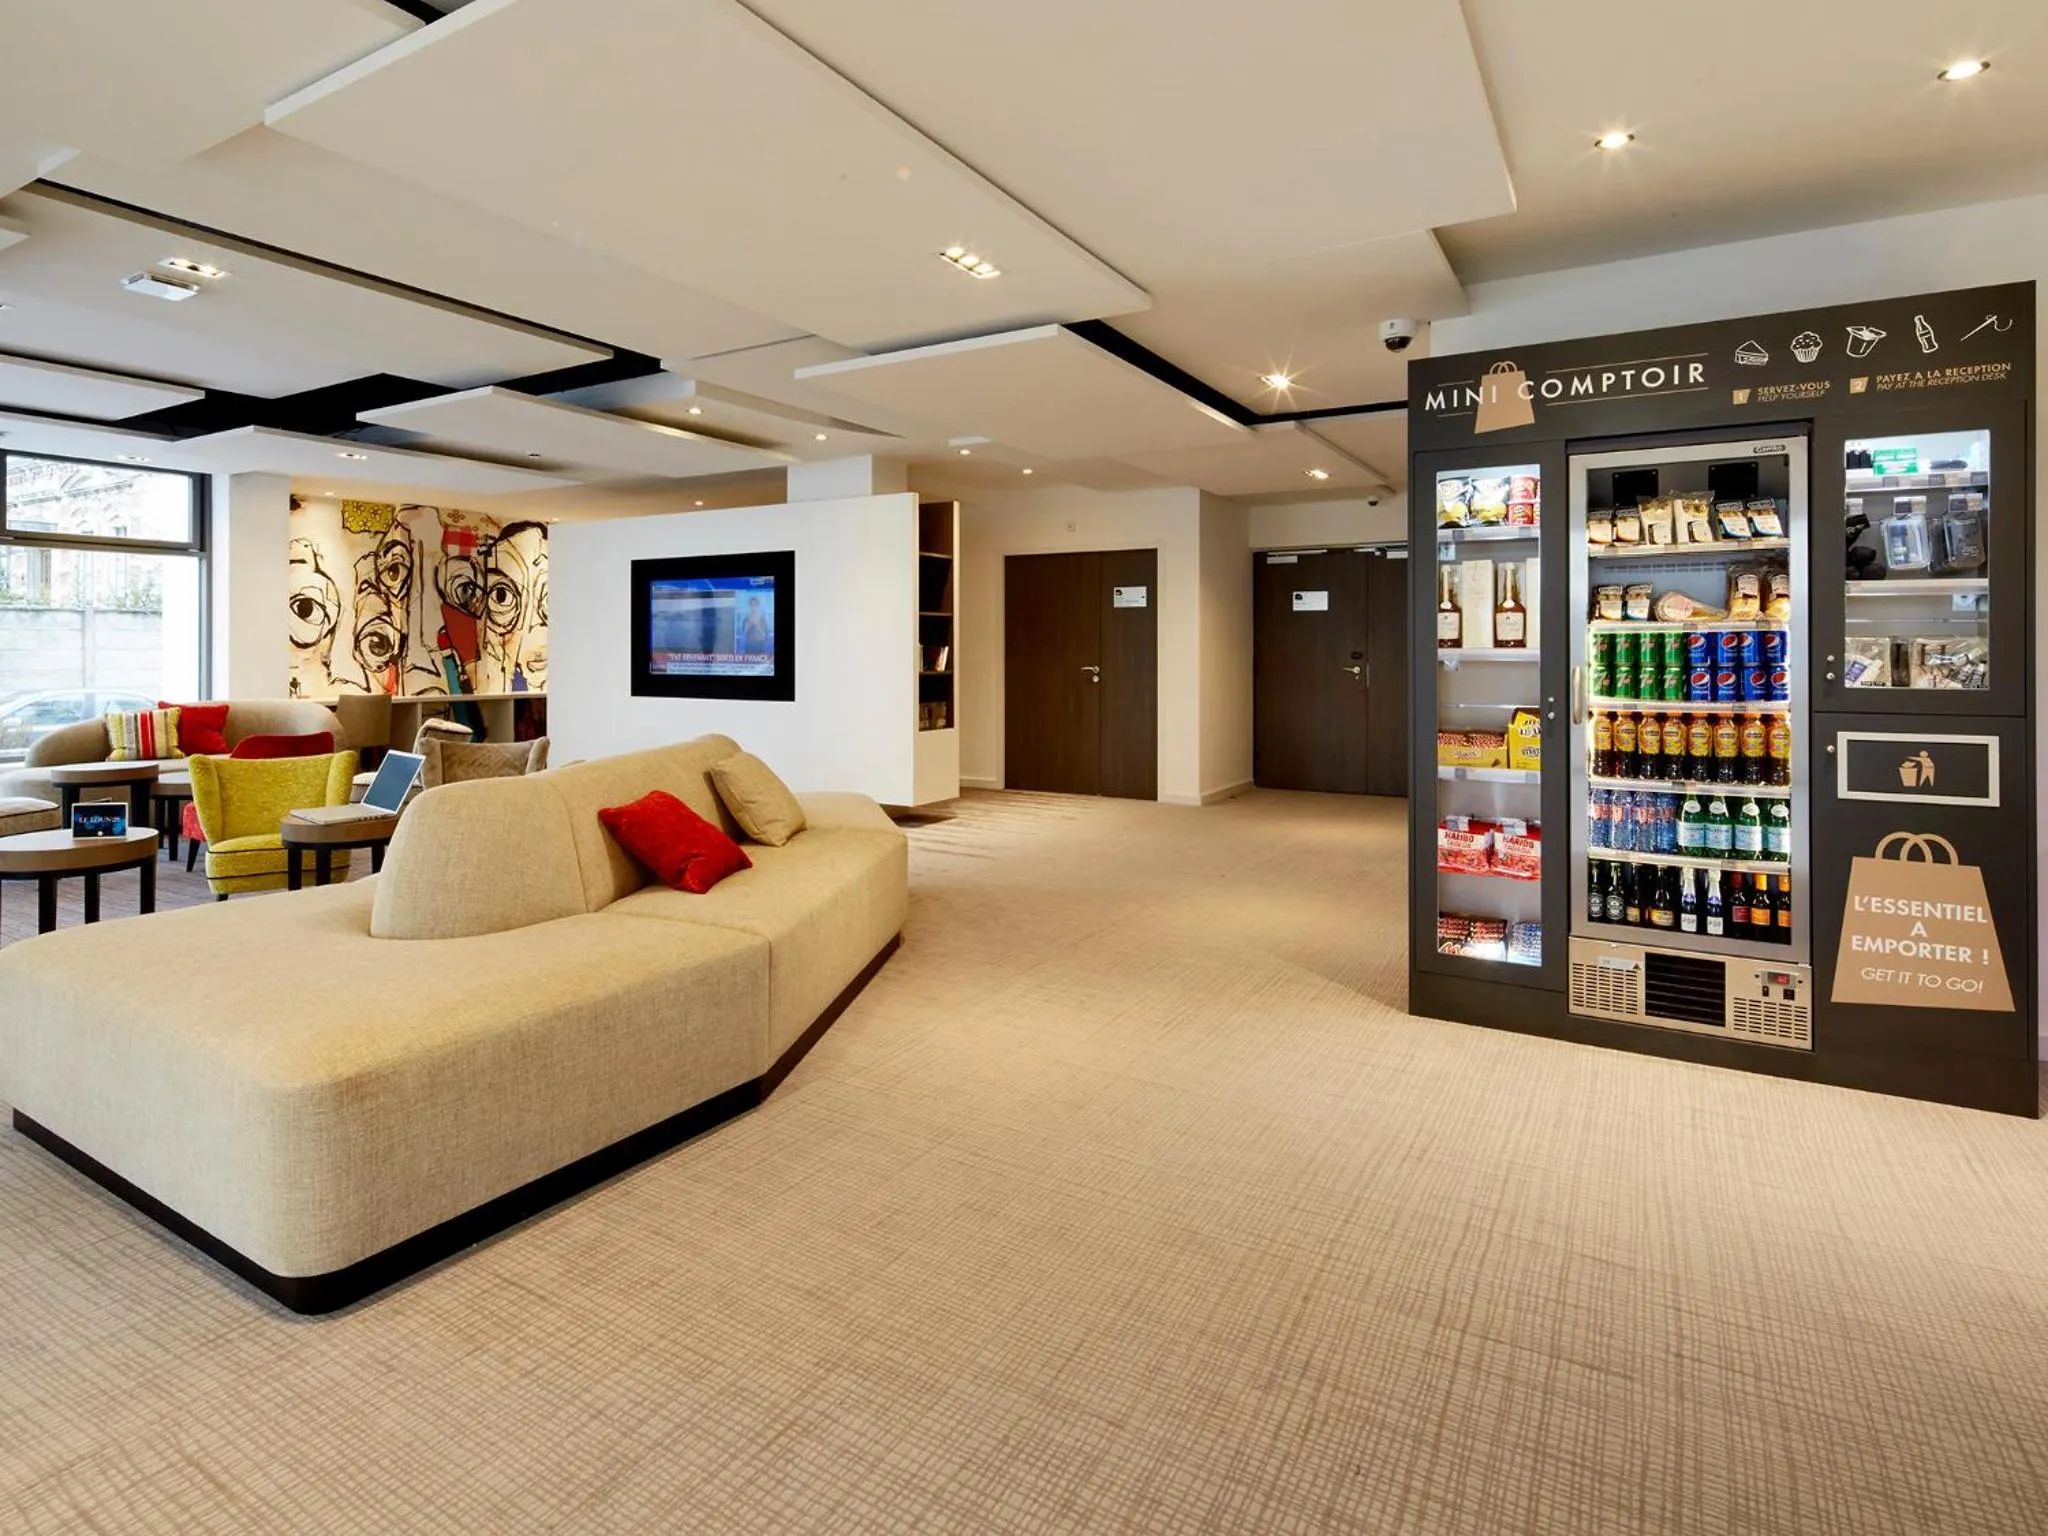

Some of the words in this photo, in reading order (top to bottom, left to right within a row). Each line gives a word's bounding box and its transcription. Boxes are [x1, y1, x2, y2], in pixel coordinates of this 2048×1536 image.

[1876, 372, 1911, 384] PAYEZ
[1915, 371, 1923, 380] A
[1927, 369, 1941, 379] LA
[1945, 362, 2011, 377] RECEPTION
[1876, 382, 1893, 392] PAY
[1895, 381, 1907, 390] AT
[1927, 374, 1980, 387] RECEPTION
[1425, 386, 1497, 411] MINI
[1517, 362, 1705, 401] COMPTOIR
[1757, 380, 1831, 396] SERVEZ-VOUS
[1444, 831, 1474, 843] HARIBO
[1503, 835, 1534, 849] HARIBO
[1854, 895, 1988, 923] L'ESSENTIEL
[1910, 920, 1928, 938] A
[1851, 935, 1973, 963] EMPORTER
[1981, 949, 1989, 965] !
[1861, 967, 1896, 982] GET
[1898, 971, 1912, 984] IT
[1916, 973, 1942, 988] TO
[1946, 977, 1985, 993] GO!
